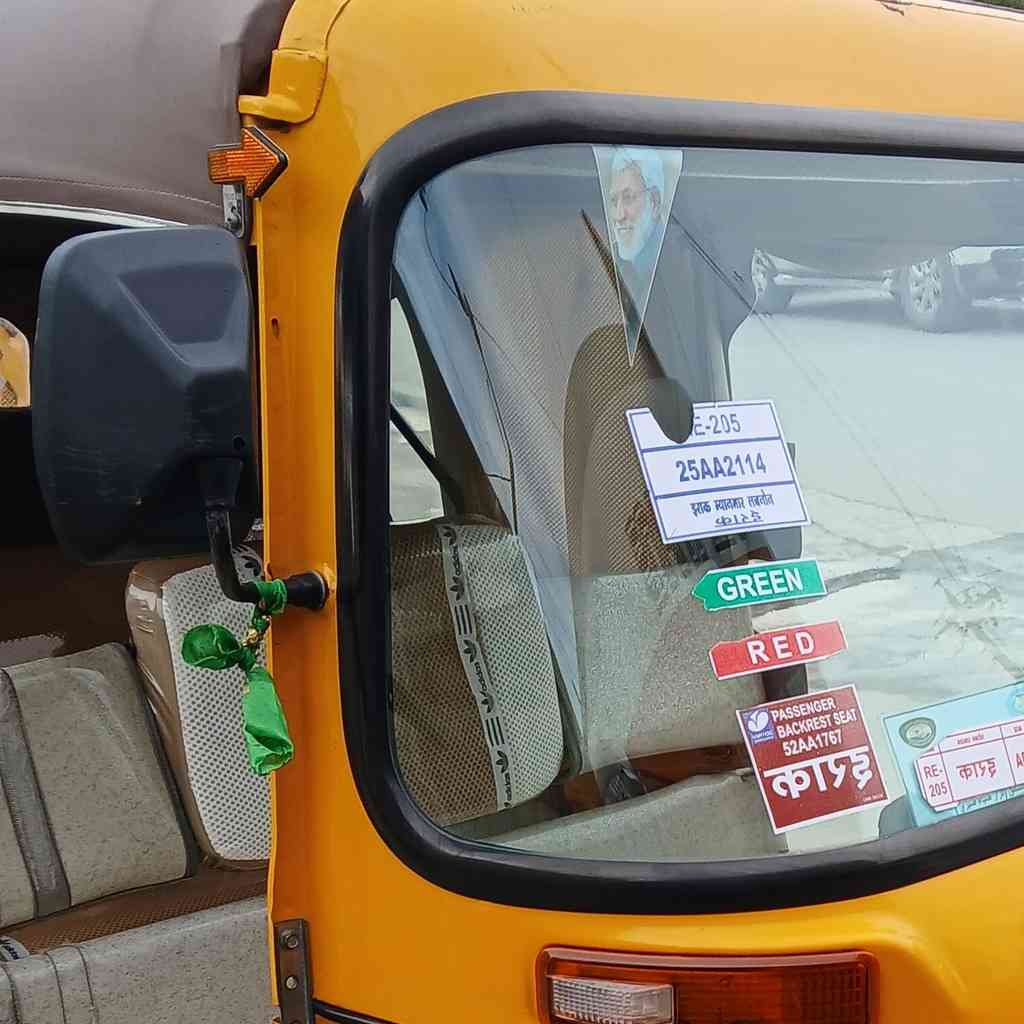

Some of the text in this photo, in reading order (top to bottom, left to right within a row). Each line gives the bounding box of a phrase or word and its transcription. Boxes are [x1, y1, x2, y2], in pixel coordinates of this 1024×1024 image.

[689, 413, 742, 438] E-205
[675, 452, 768, 483] 25AA2114
[716, 567, 804, 601] GREEN
[746, 631, 816, 665] RED
[770, 697, 837, 722] PASSENGER
[776, 714, 833, 739] BACKREST
[832, 708, 858, 726] SEAT
[782, 729, 843, 756] 52AA1767
[928, 782, 948, 798] 205
